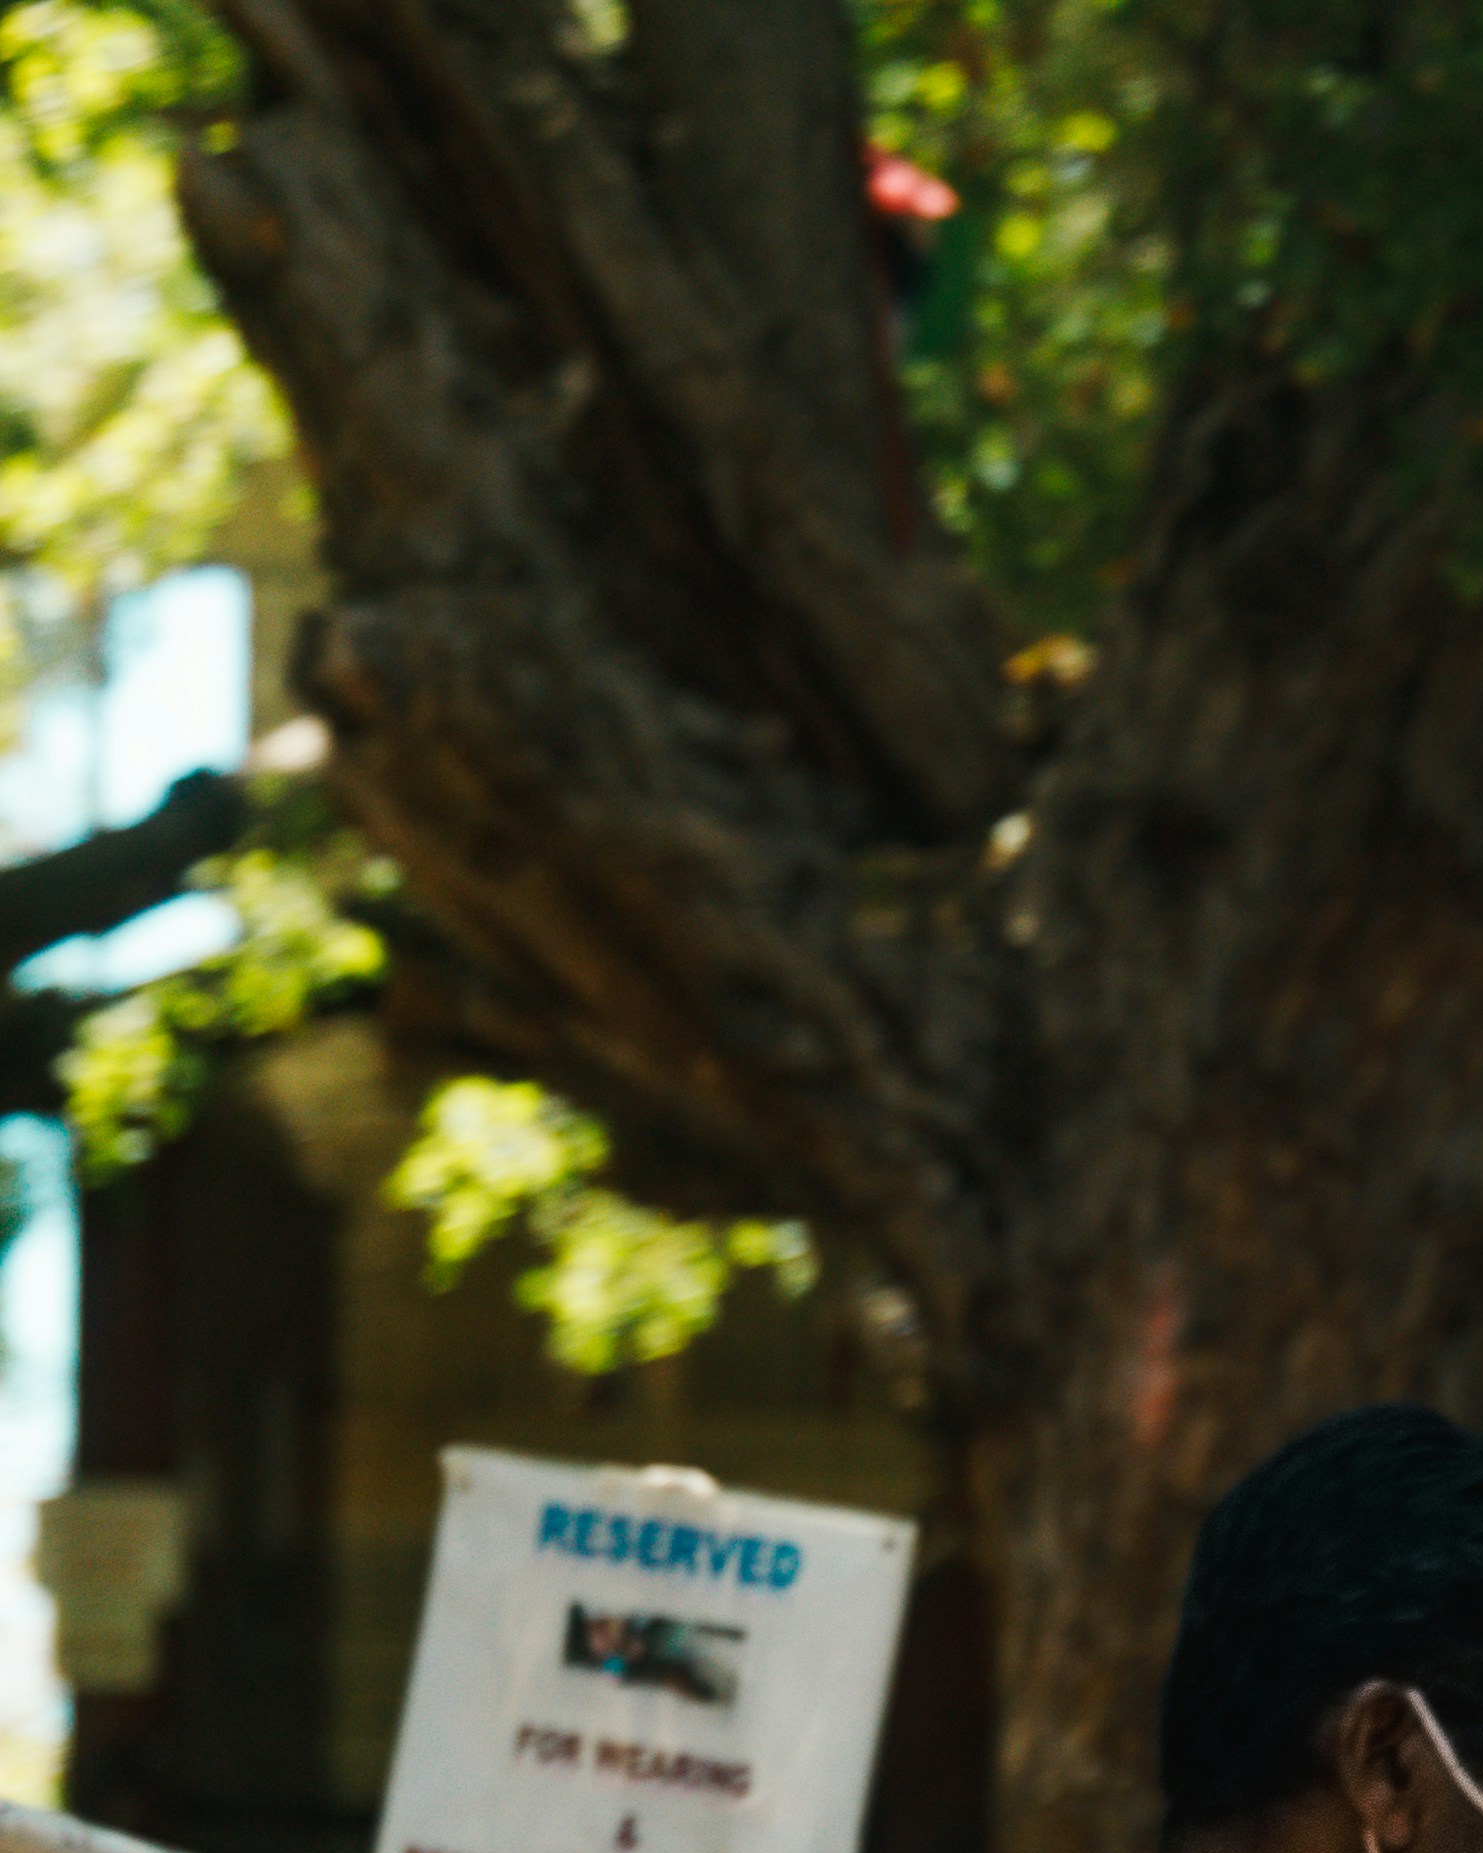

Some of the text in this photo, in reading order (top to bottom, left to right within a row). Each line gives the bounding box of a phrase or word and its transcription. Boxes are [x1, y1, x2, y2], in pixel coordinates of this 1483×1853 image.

[538, 1502, 802, 1591] RESERVED
[514, 1723, 753, 1797] FOR WEARING
[615, 1813, 638, 1852] &
